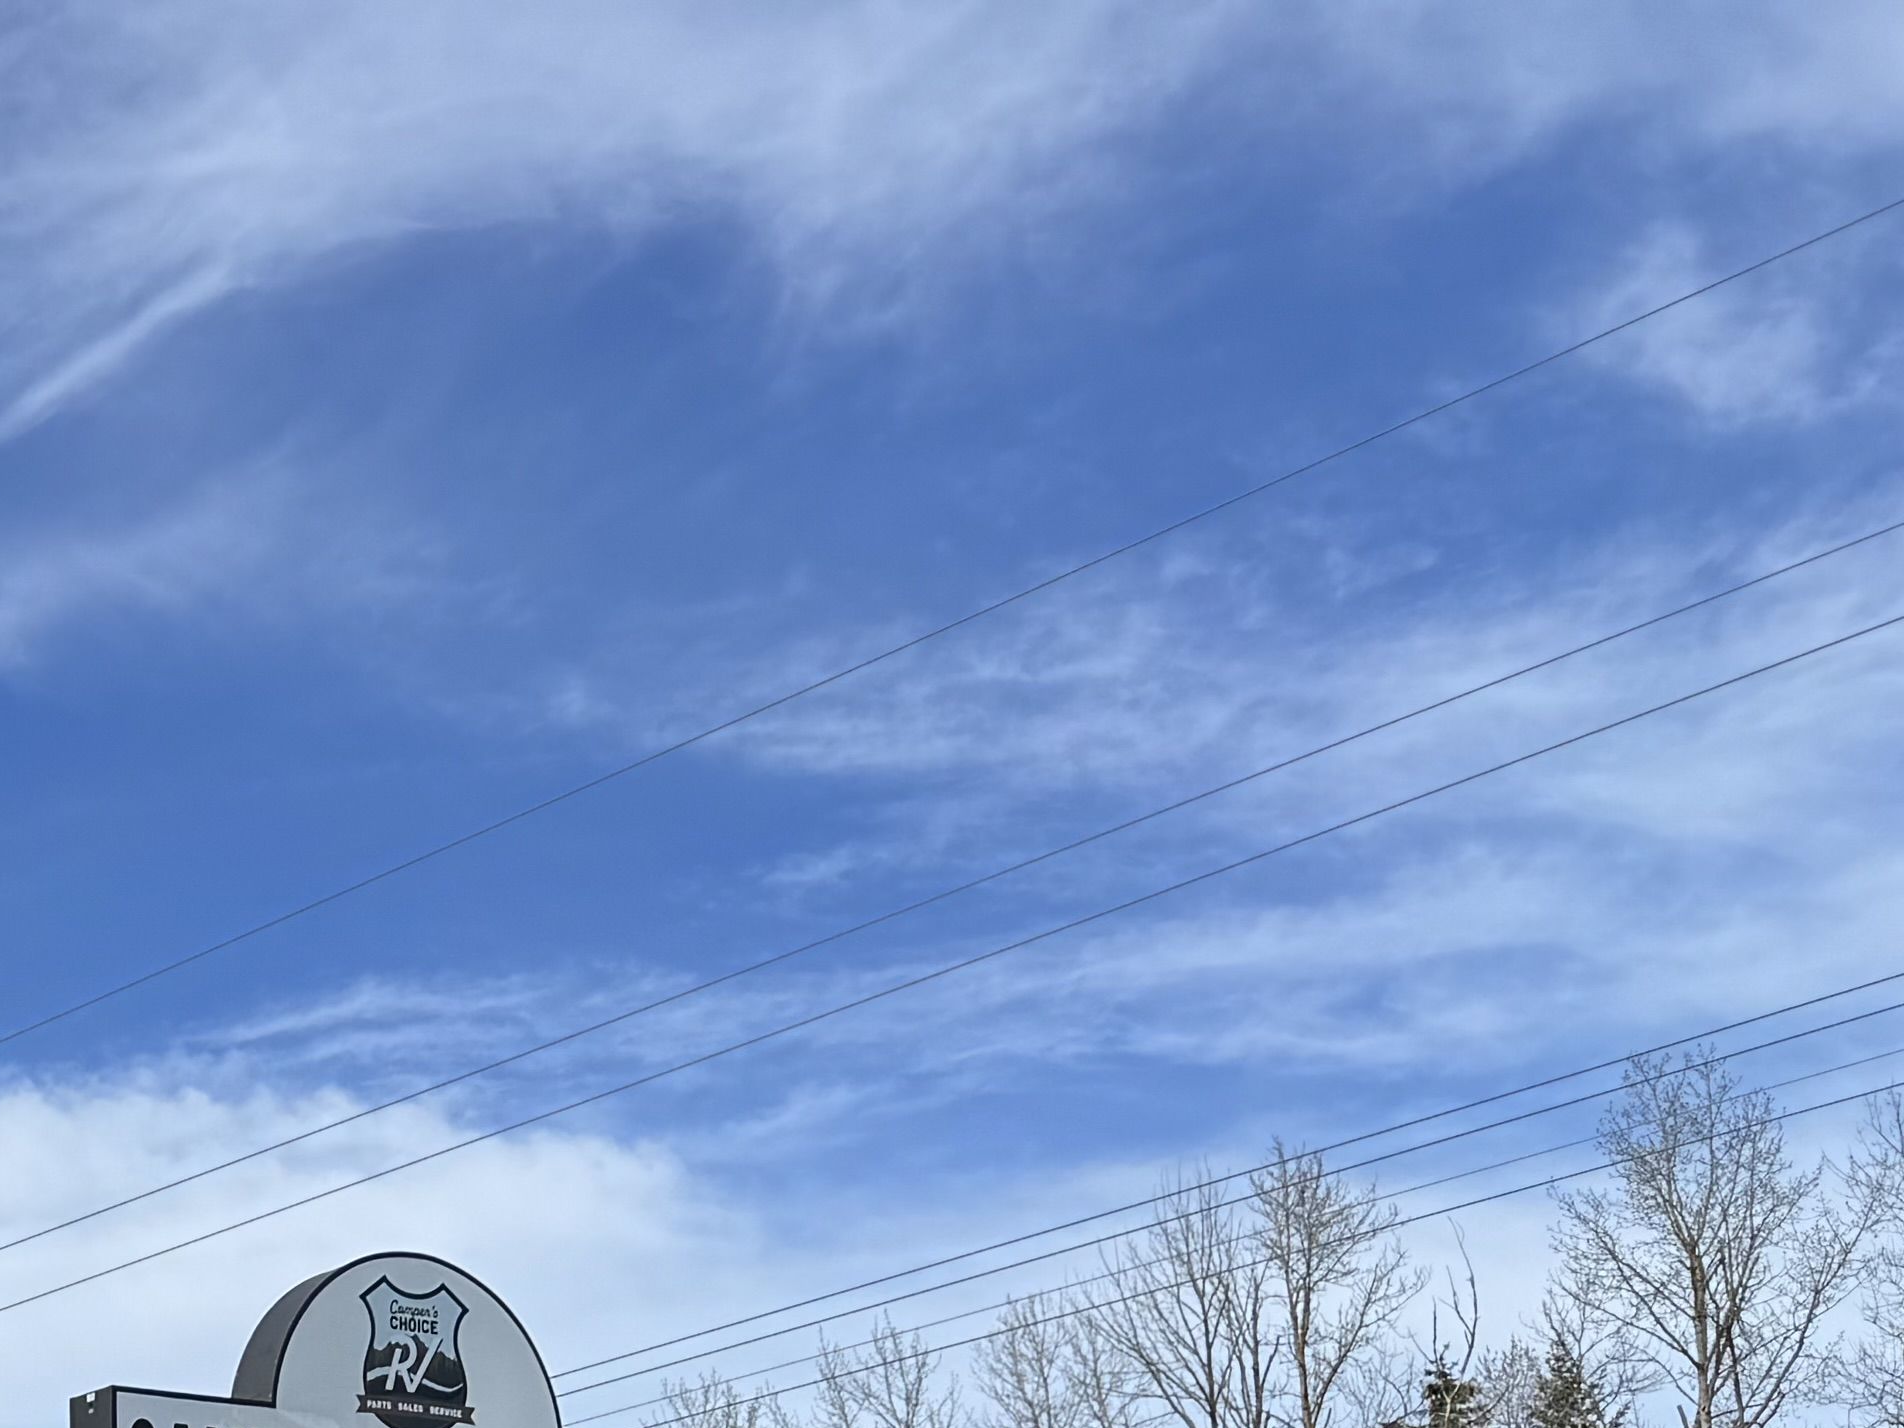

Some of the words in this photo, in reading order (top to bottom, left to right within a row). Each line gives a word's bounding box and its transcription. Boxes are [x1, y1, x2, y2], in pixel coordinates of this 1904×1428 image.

[389, 1299, 439, 1318] Camper's
[389, 1316, 439, 1335] CHOICE
[385, 1333, 444, 1393] RV
[366, 1399, 392, 1410] PARTS
[397, 1402, 424, 1413] SALES
[429, 1405, 463, 1418] SERVICE
